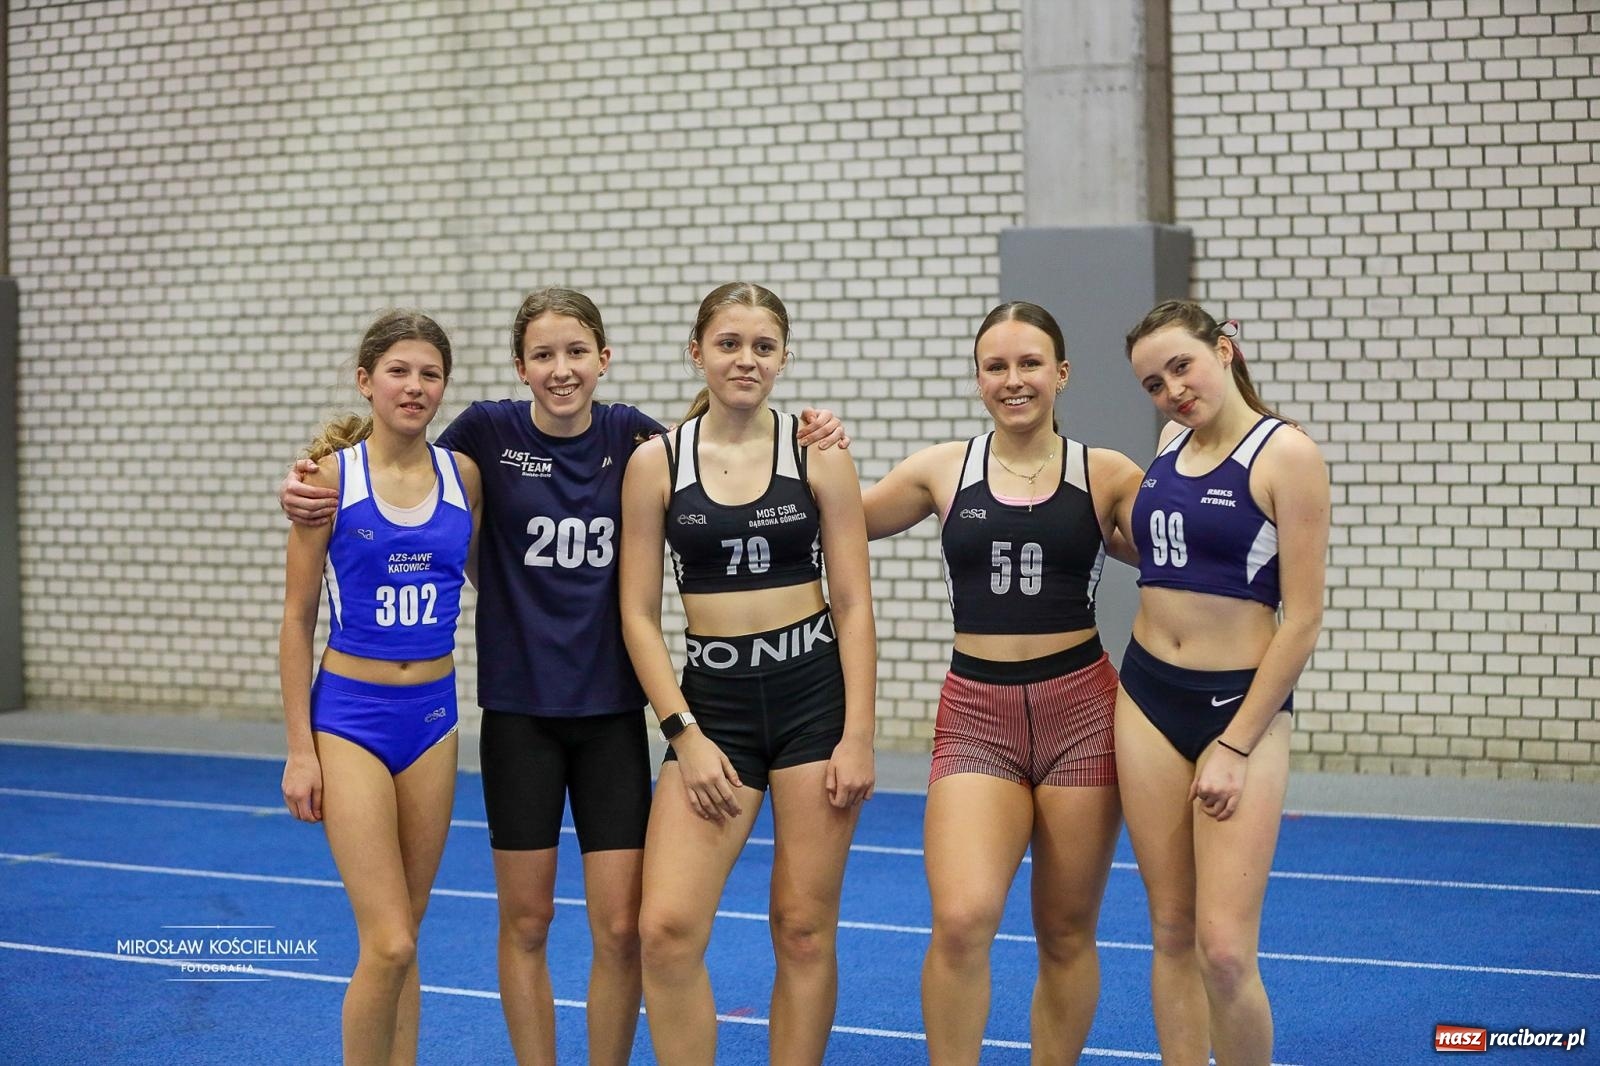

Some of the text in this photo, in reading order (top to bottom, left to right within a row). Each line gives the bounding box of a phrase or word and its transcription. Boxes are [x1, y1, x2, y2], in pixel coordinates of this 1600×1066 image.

[501, 449, 531, 462] JUST
[521, 462, 552, 472] TEAM
[1207, 488, 1233, 497] RMKS
[1200, 497, 1237, 508] RYBNIK
[756, 503, 798, 519] MOS CSIR
[960, 508, 987, 519] esa
[748, 511, 807, 529] DĄBROWA GÓRNICZA
[524, 516, 614, 569] 203
[1150, 509, 1188, 568] 99
[388, 552, 433, 562] AZS-AWF
[721, 536, 770, 576] 70
[388, 562, 431, 574] KATOWICE
[991, 541, 1043, 596] 59
[376, 582, 438, 627] 302
[750, 612, 836, 667] NIK
